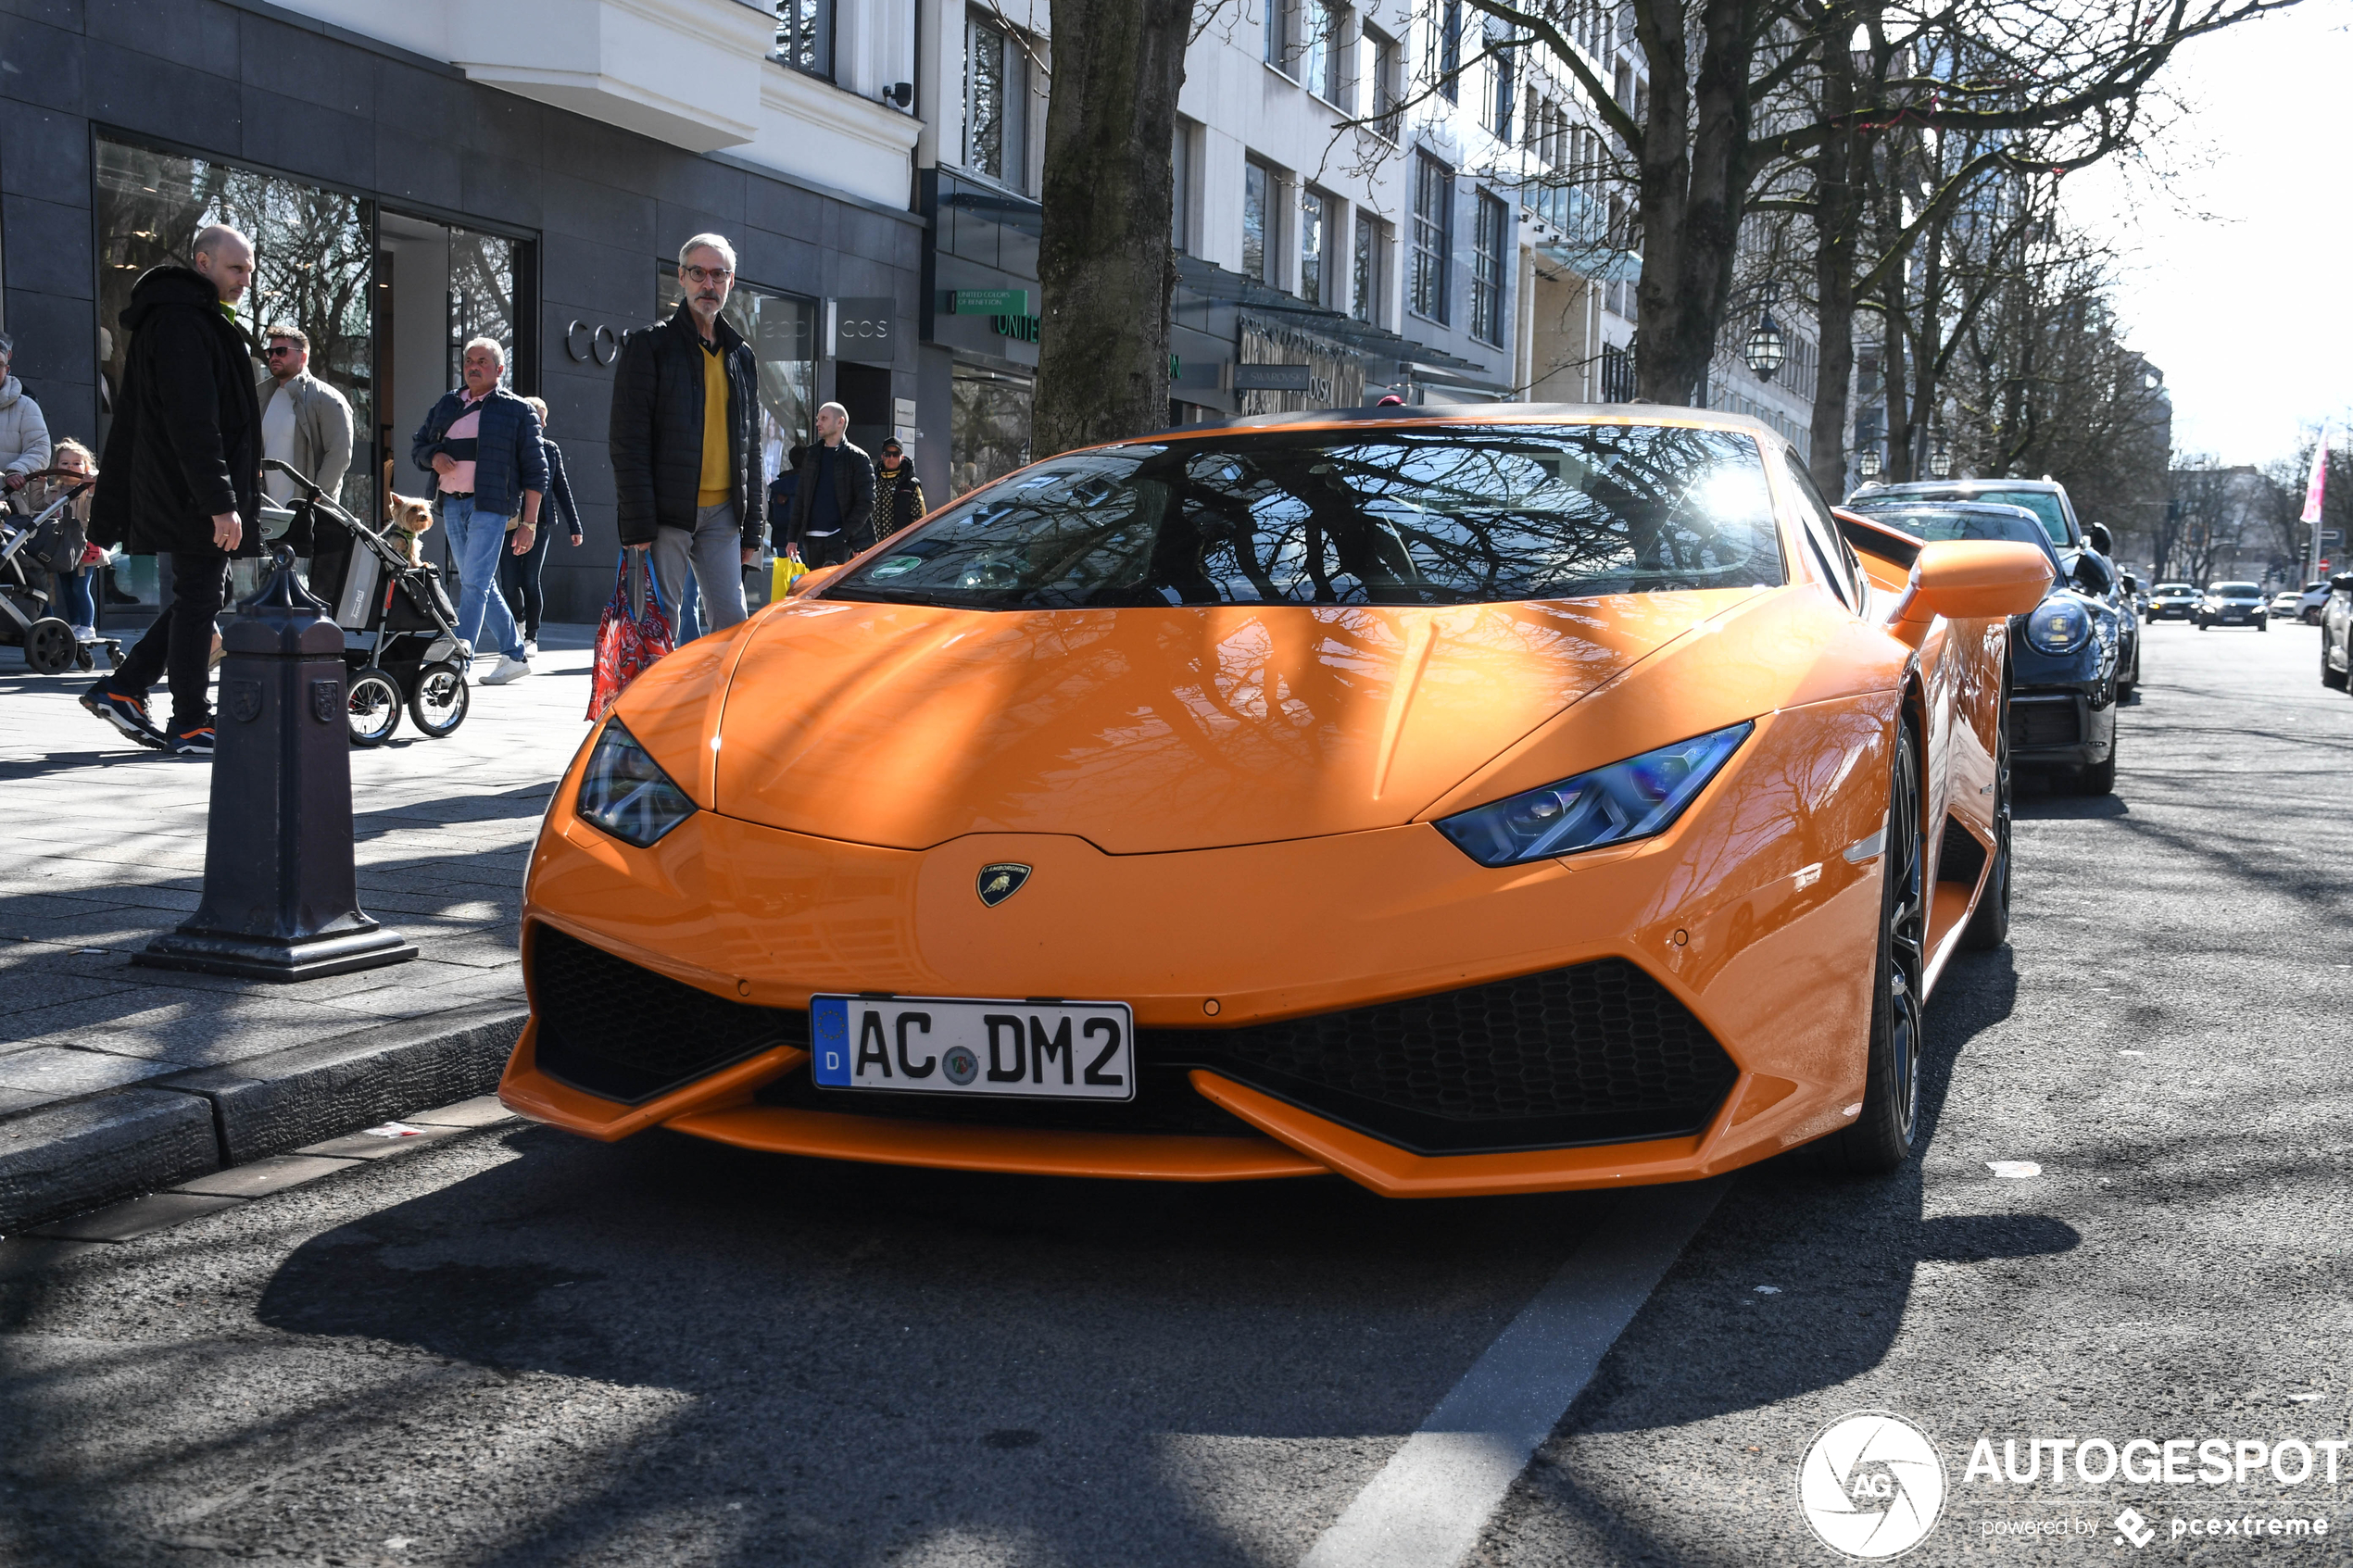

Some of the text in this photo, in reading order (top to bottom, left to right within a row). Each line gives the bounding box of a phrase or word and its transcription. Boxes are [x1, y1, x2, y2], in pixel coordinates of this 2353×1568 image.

[841, 320, 887, 338] COS
[997, 314, 1041, 344] UNITE
[1250, 372, 1306, 383] SWAROVSKI
[984, 865, 1028, 874] LAMBORGHINI
[856, 1010, 937, 1079] AC
[826, 1051, 839, 1070] D
